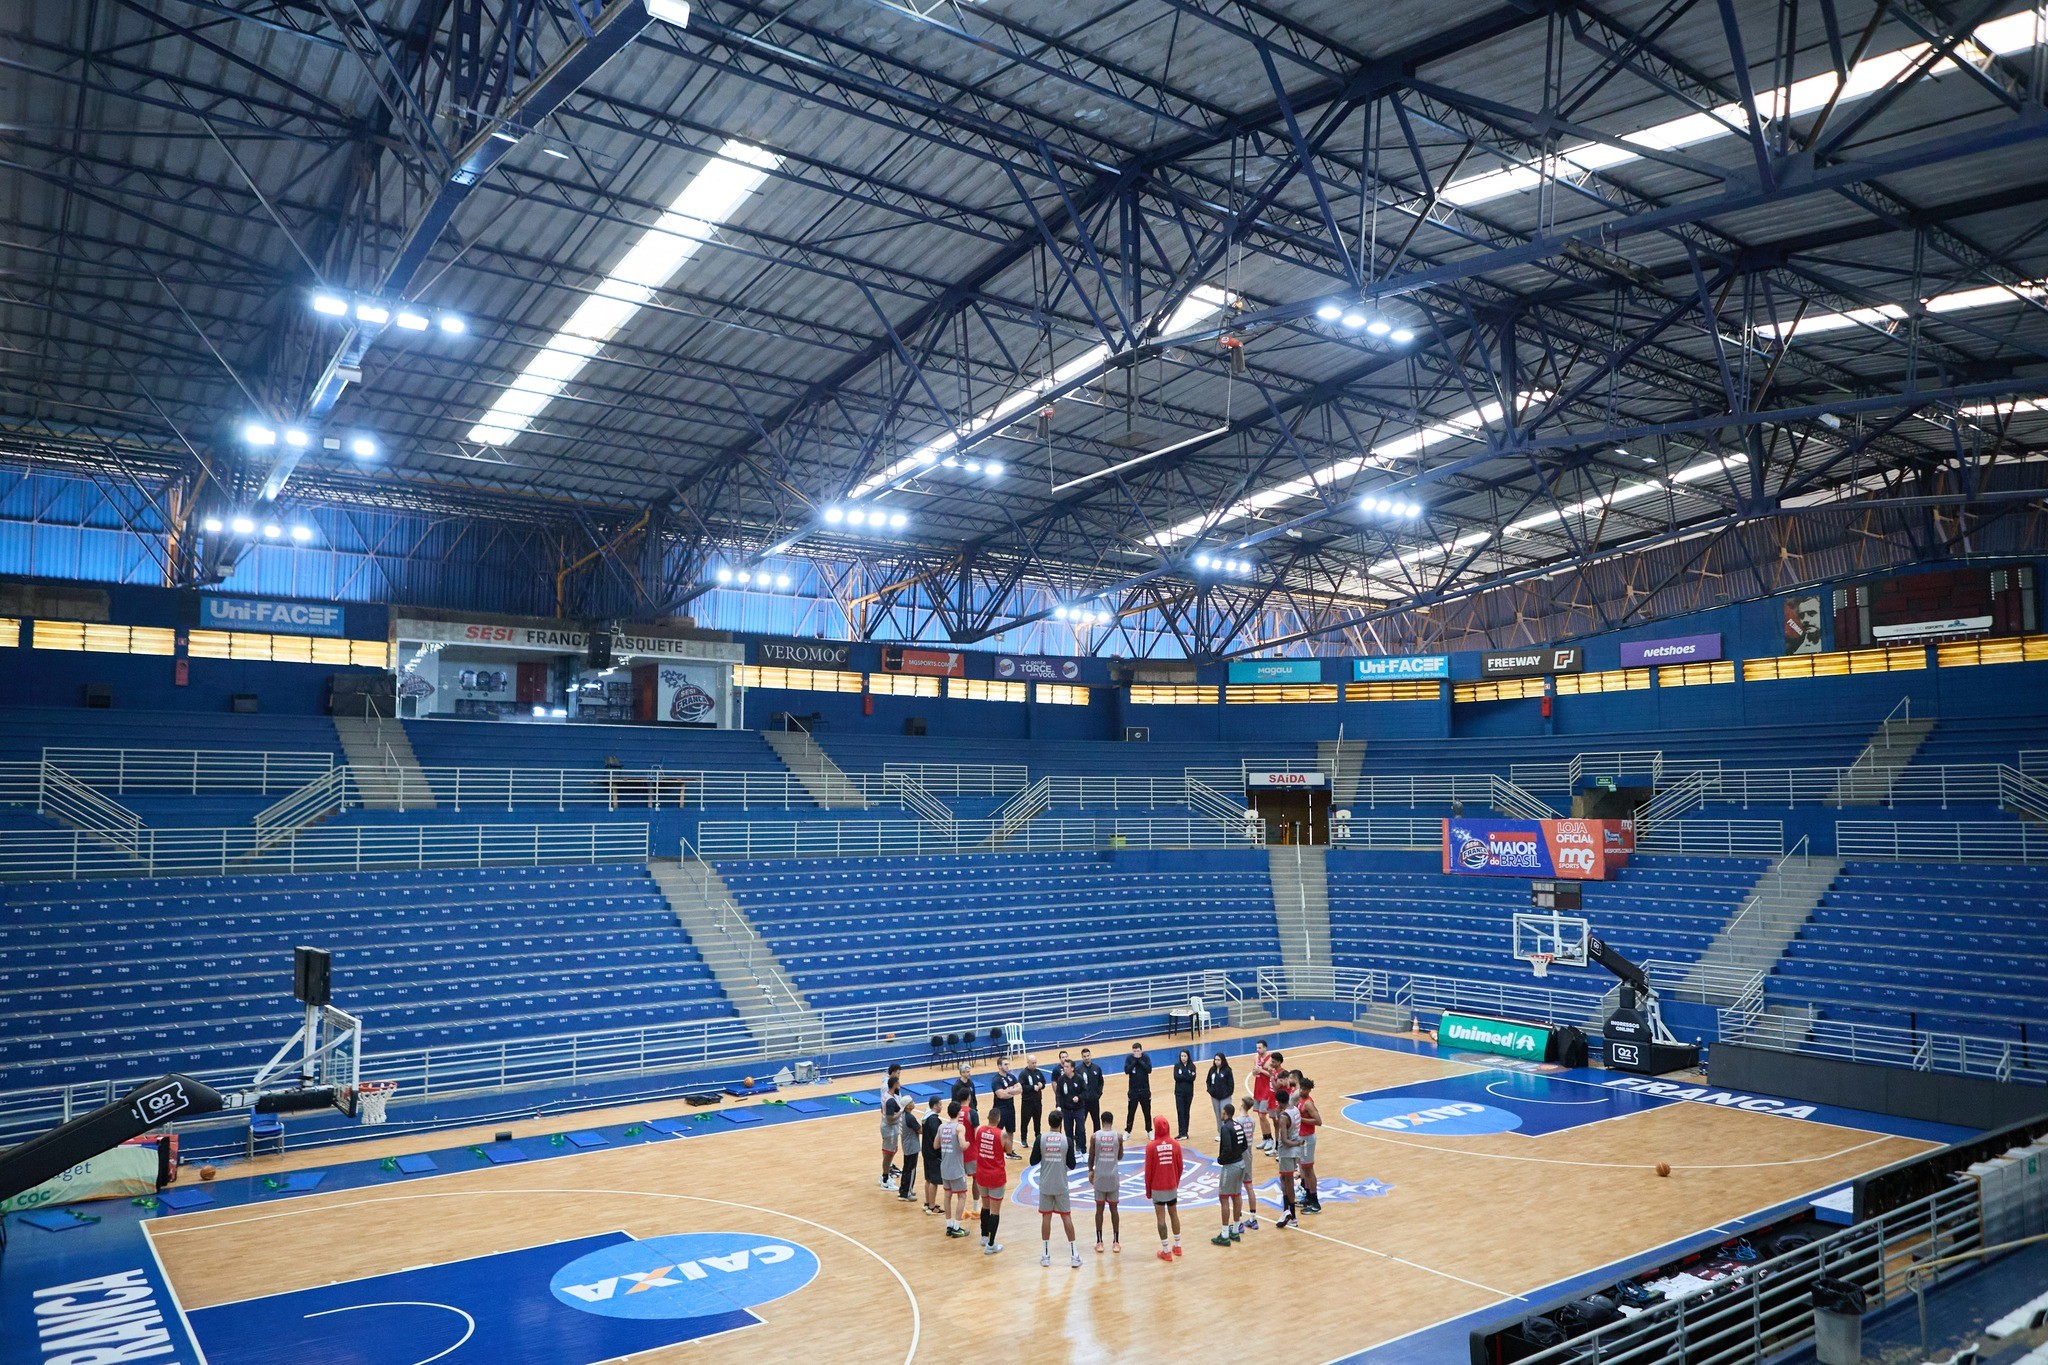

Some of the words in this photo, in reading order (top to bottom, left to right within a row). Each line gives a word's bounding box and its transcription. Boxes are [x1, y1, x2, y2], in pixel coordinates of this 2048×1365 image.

[210, 600, 339, 626] Uni-FACEF
[465, 626, 514, 642] SESI
[612, 636, 683, 653] ASQUETE
[763, 644, 847, 664] VEROMOC
[1487, 655, 1542, 668] FREEWAY
[1359, 658, 1445, 674] Uni-FACEF
[1557, 822, 1588, 834] LOJA
[1556, 834, 1594, 844] OFICIAL
[1490, 842, 1537, 855] MAIOR
[1490, 857, 1500, 866] do
[1500, 854, 1541, 868] BRASIL
[1448, 1024, 1513, 1049] Unimed
[1618, 1047, 1632, 1058] Q2
[148, 1093, 175, 1110] Q2
[1602, 1077, 1818, 1119] FRANCA
[1366, 1103, 1485, 1130] CAIXA
[560, 1245, 795, 1302] CAIXA
[33, 1268, 181, 1365] RANCA
